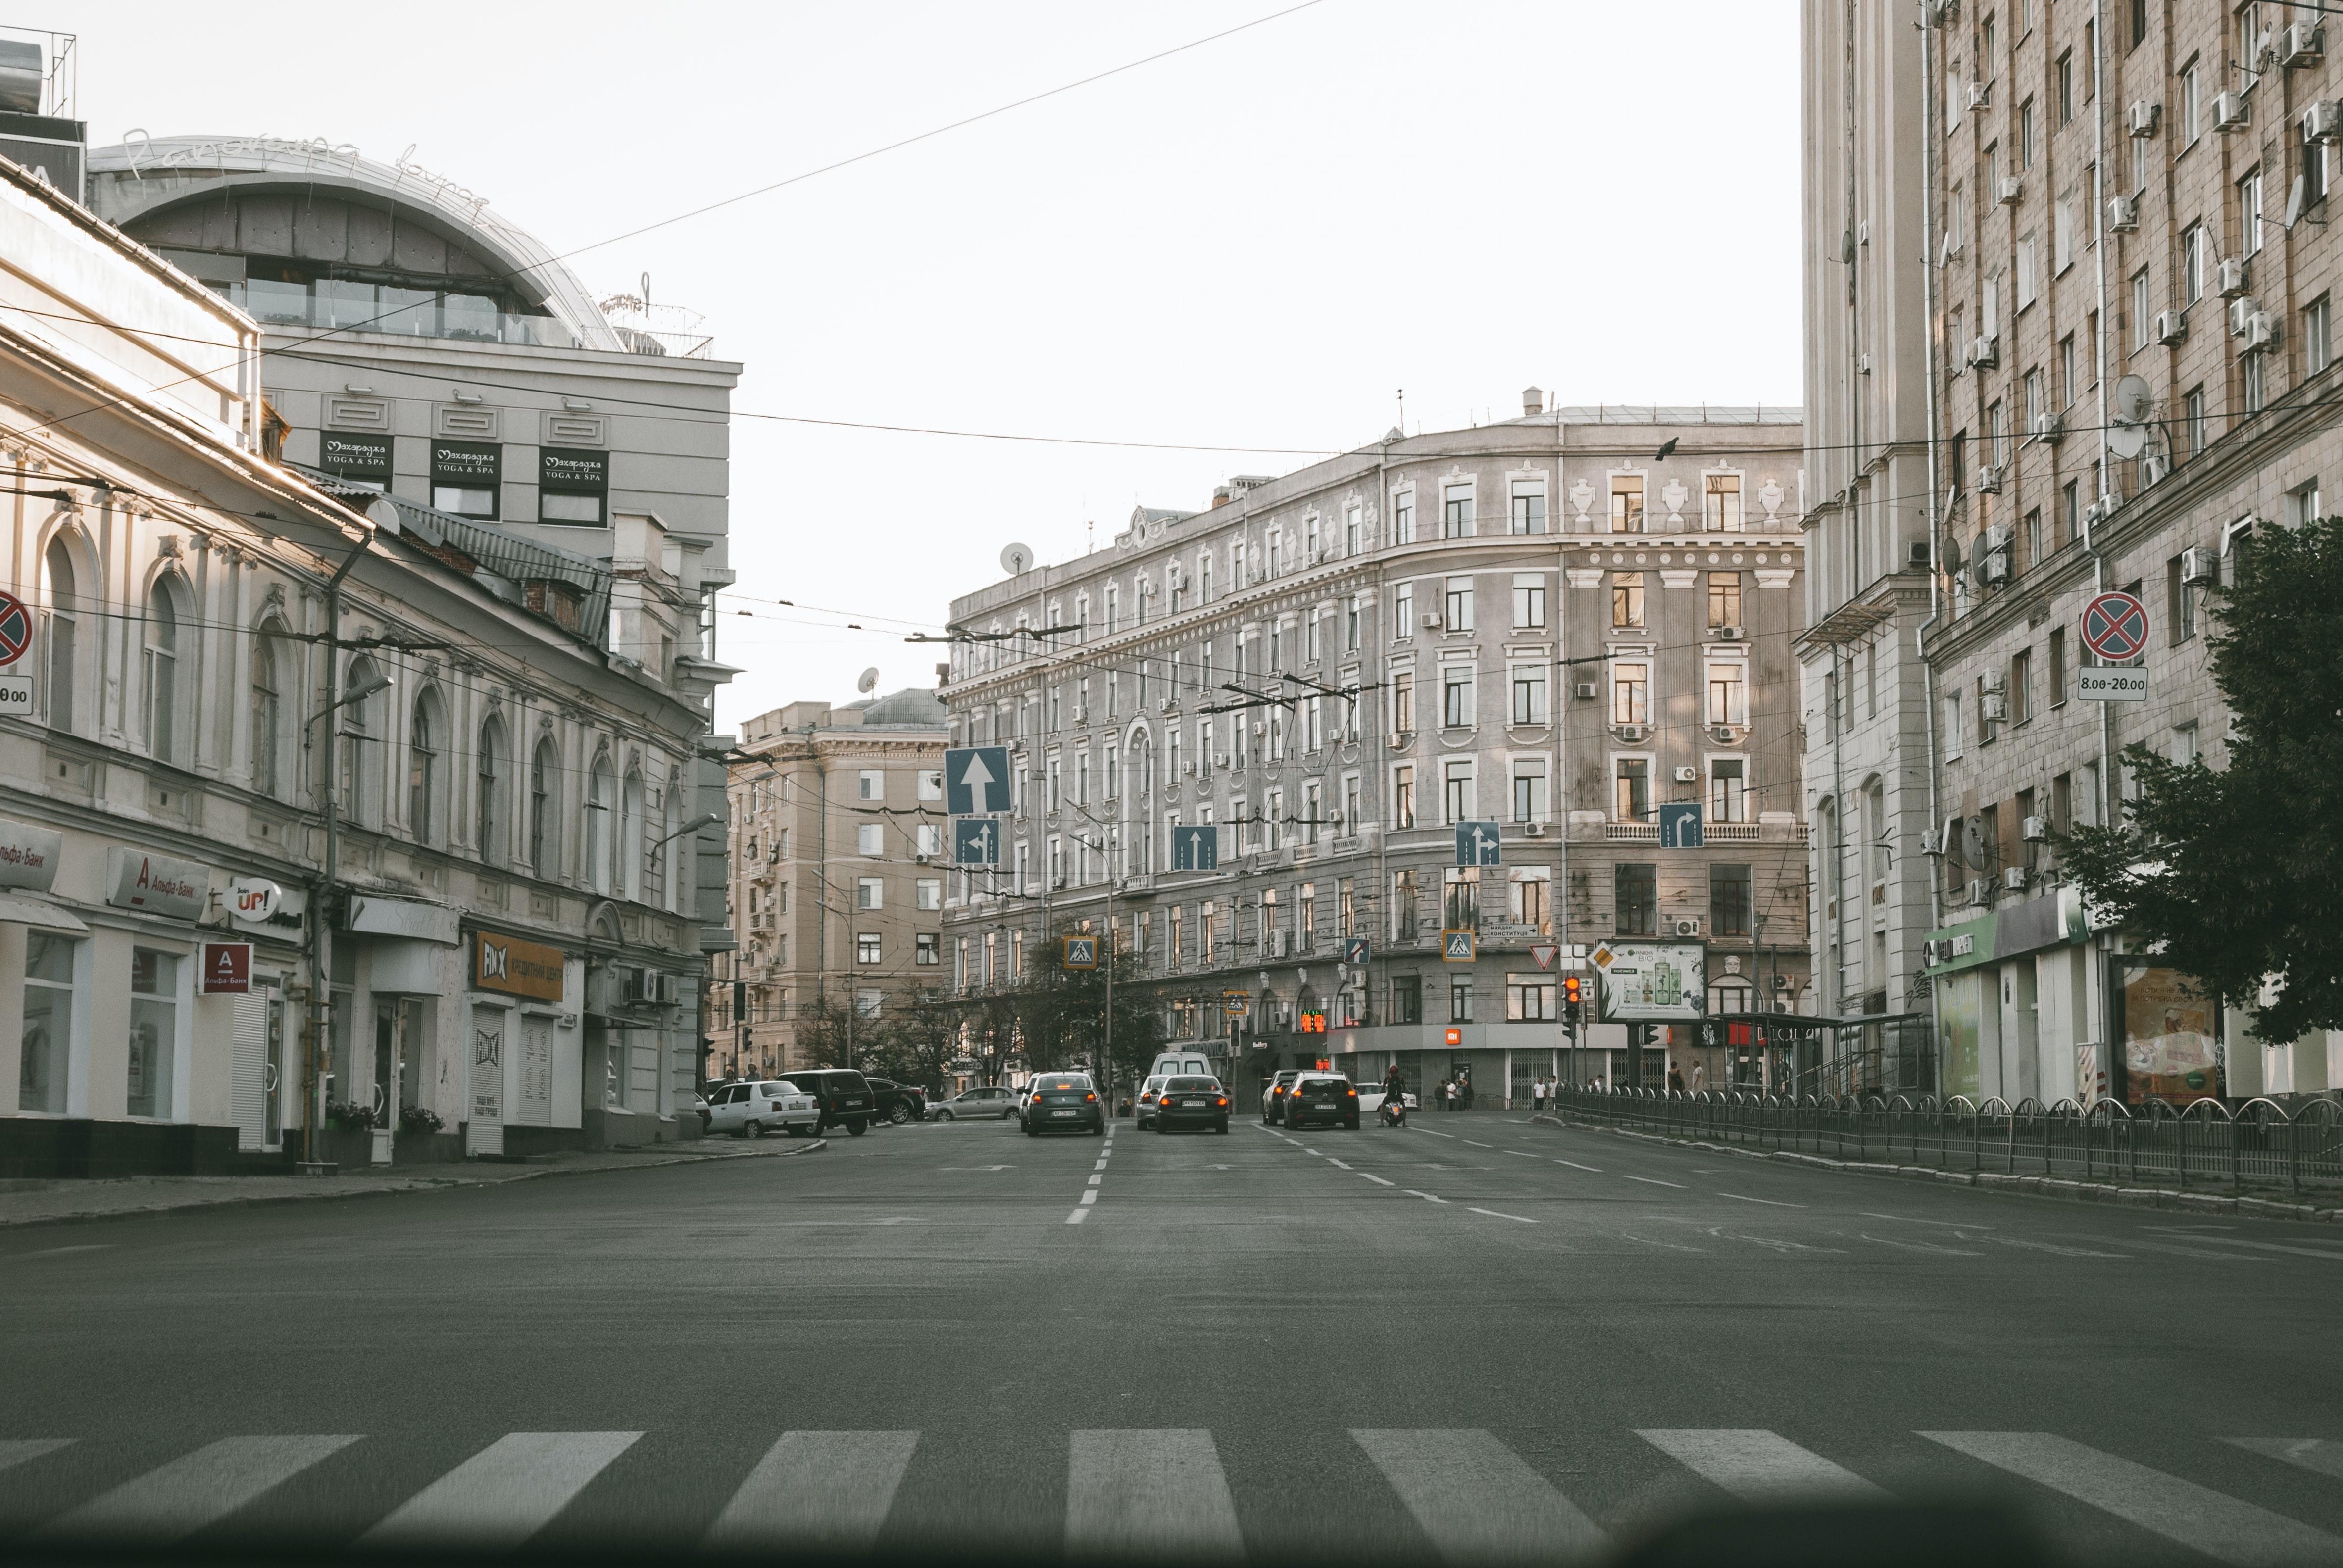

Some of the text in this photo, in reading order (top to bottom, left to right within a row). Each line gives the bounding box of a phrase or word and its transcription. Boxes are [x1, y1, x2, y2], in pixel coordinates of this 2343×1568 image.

[123, 128, 361, 180] Panorama
[327, 441, 385, 457] Махараджа
[437, 449, 494, 466] Махараджа
[546, 457, 601, 473] Махараджа
[238, 889, 270, 911] UP!
